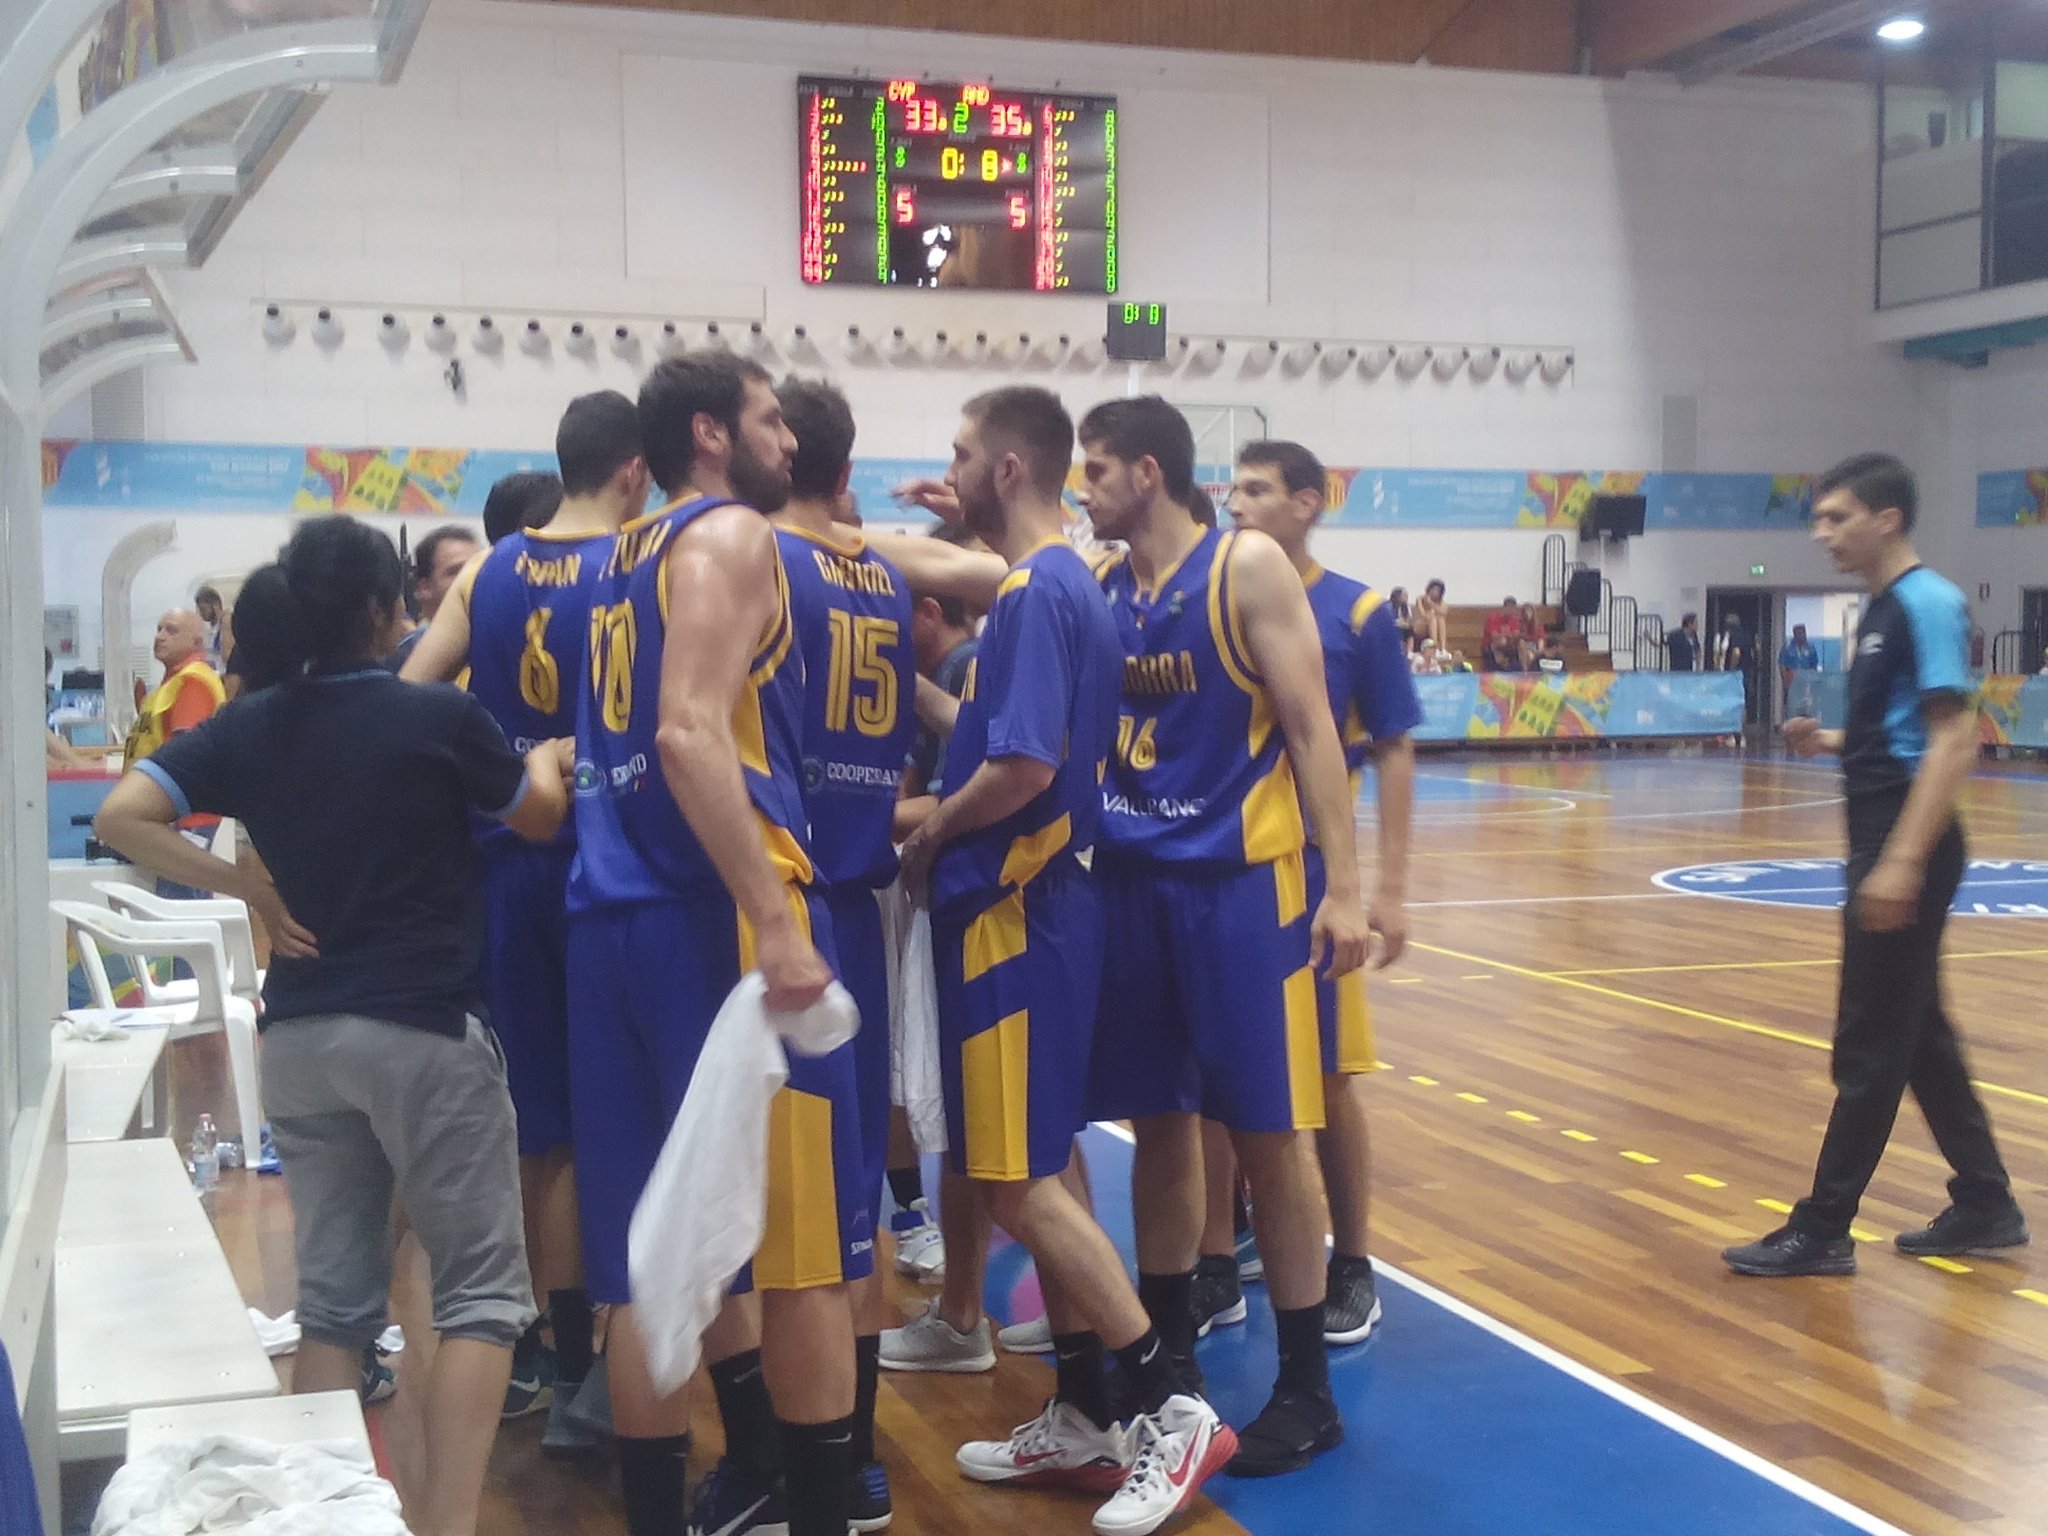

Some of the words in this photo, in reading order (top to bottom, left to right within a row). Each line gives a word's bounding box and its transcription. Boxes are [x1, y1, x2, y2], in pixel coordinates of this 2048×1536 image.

[888, 80, 916, 101] CYP
[905, 99, 938, 131] 33
[952, 101, 969, 133] 2
[990, 103, 1023, 136] 35
[896, 190, 914, 223] 5
[1009, 195, 1026, 228] 5
[519, 606, 560, 714] 6
[590, 597, 638, 734] 10
[825, 607, 899, 737] 15
[1116, 714, 1158, 771] 16
